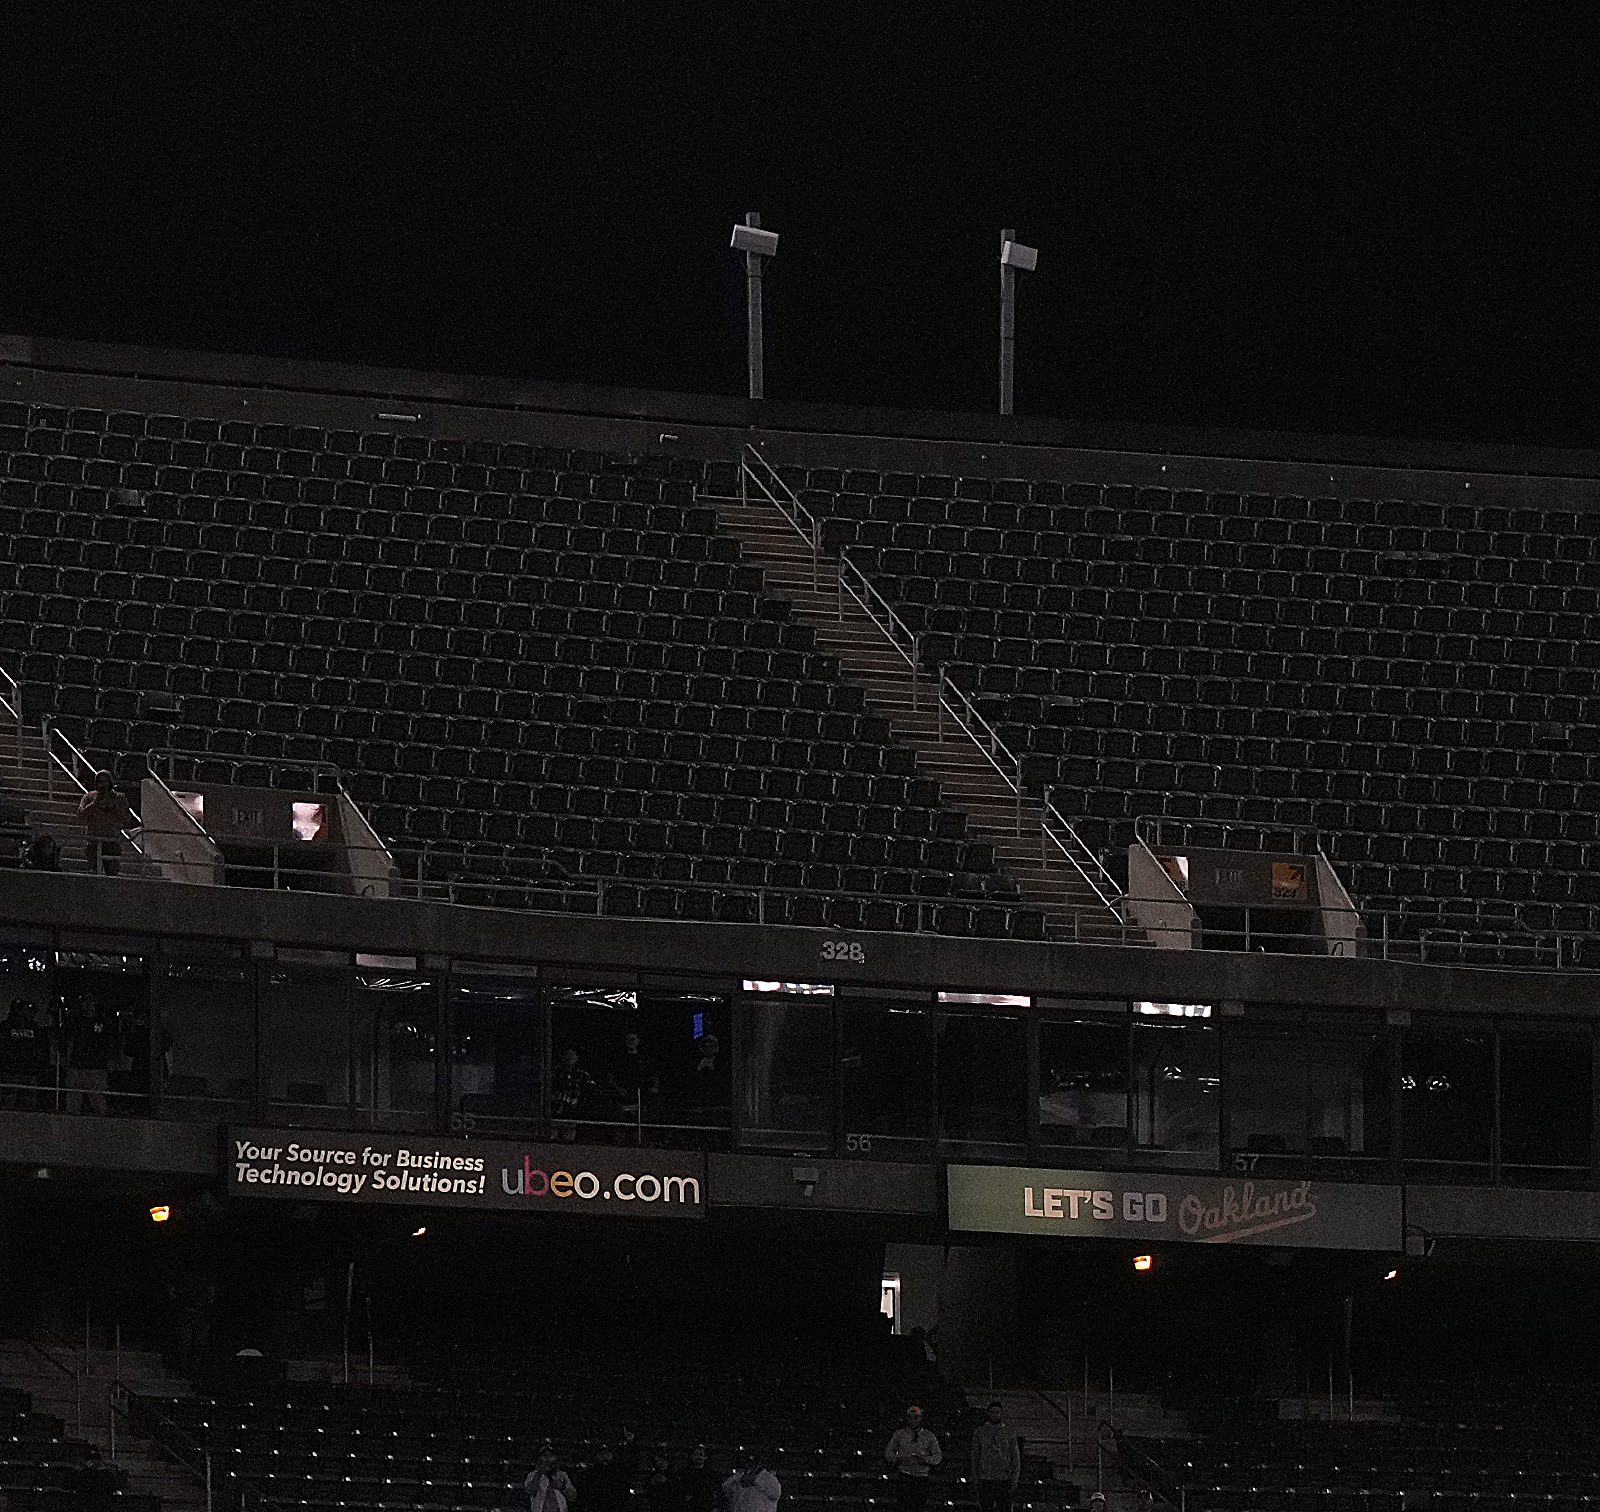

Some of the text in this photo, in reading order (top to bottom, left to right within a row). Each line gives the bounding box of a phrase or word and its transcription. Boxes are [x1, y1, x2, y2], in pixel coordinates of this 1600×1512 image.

[821, 941, 861, 961] 328
[234, 1141, 486, 1172] Your Source for Business
[1236, 1156, 1258, 1171] 57
[234, 1162, 487, 1196] Technology Solutions!
[501, 1153, 702, 1205] ubeo.com
[1024, 1180, 1318, 1240] LET'S GO Oakland
